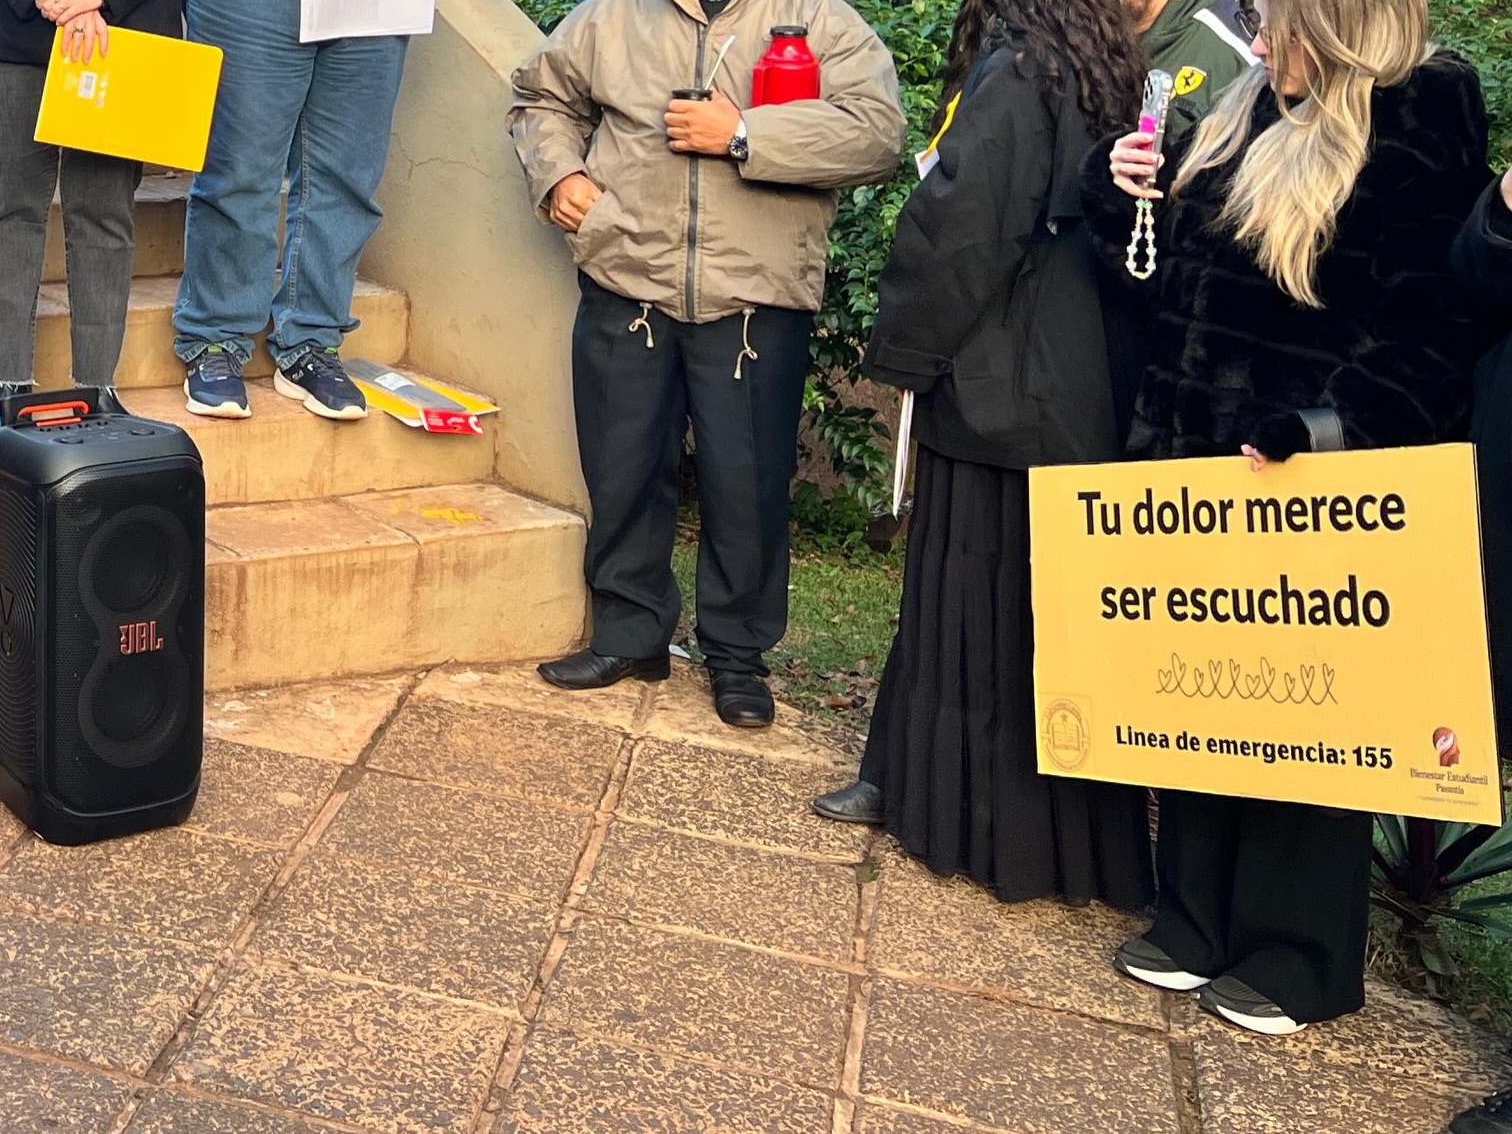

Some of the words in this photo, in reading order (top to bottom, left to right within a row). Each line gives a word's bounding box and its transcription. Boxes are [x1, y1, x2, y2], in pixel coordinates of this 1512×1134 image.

[1077, 491, 1122, 536] Tu
[1133, 486, 1234, 535] dolor
[1245, 493, 1406, 533] merece
[1100, 586, 1157, 621] ser
[1166, 574, 1390, 628] escuchado
[119, 620, 164, 656] JBL
[1115, 725, 1170, 749] Linea
[1175, 730, 1201, 752] de
[1206, 737, 1346, 766] emergencia:
[1352, 745, 1393, 770] 155
